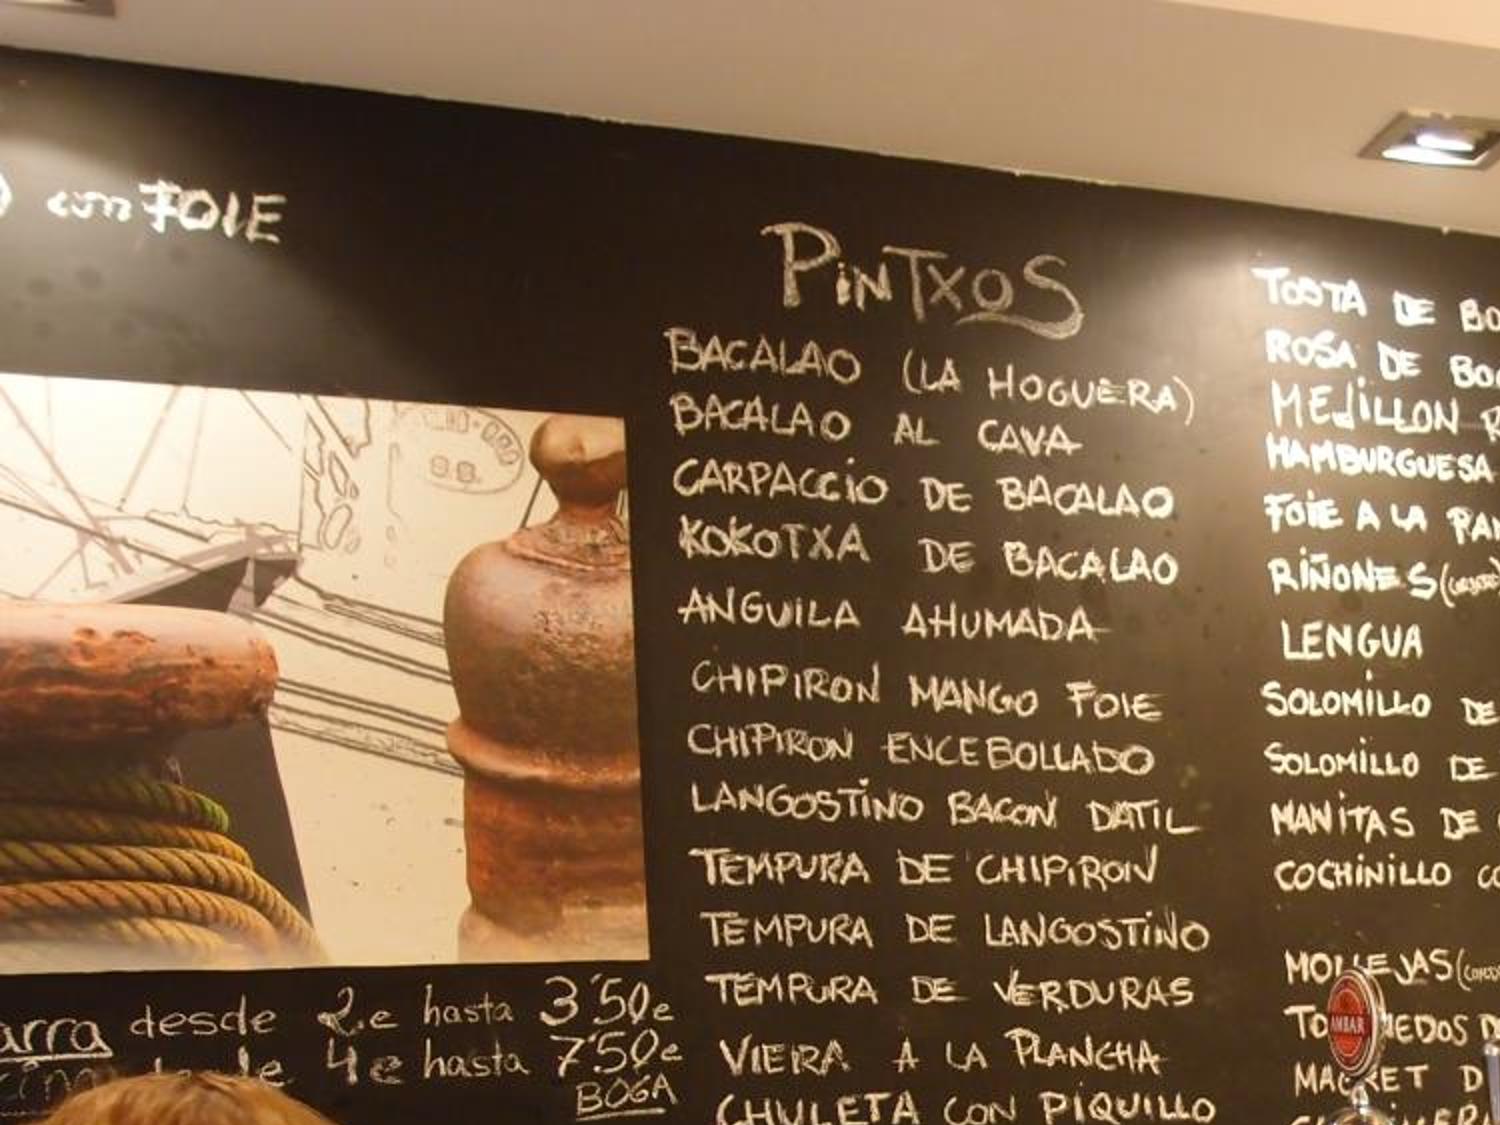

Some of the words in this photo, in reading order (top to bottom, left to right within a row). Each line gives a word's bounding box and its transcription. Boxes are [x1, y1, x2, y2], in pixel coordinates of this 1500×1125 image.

[139, 179, 287, 243] FOIE
[1251, 265, 1368, 318] TOSTA
[1393, 290, 1436, 325] DE
[664, 326, 861, 384] BACALAO
[902, 348, 963, 395] (LA
[988, 364, 1195, 425] HOGUERA)
[1265, 329, 1357, 370] ROSA
[1377, 342, 1422, 380] DE
[670, 395, 851, 440] BACALAO
[893, 413, 939, 446] AL
[978, 419, 1083, 455] CAVA
[1271, 377, 1461, 434] MEJILLON
[1265, 432, 1494, 483] HAMBURGUESA
[672, 457, 888, 505] CARPACCIO
[920, 475, 972, 513] DE
[996, 475, 1174, 518] BACALAO
[1263, 490, 1342, 533] FOIE
[1355, 499, 1380, 531] A
[1392, 500, 1428, 532] LA
[678, 516, 871, 562] KOKOTXA
[918, 538, 978, 574] DE
[1003, 541, 1178, 585] BACALAO
[678, 587, 860, 630] ANGUILA
[902, 602, 1112, 642] AHUMADA
[1281, 620, 1424, 660] LENGUA
[691, 660, 880, 705] CHIPIRON
[909, 675, 1039, 717] MANGO
[1066, 680, 1163, 722] FOIE
[1261, 670, 1431, 718] SOLOMILLO
[687, 723, 853, 761] CHIPIRON
[886, 731, 1155, 776] ENCEBOLLADO
[1263, 737, 1420, 778] SOLOMILLO
[1450, 755, 1498, 783] DE
[691, 777, 925, 824] LANGOSTINO
[948, 794, 1058, 828] BACON
[1090, 798, 1204, 835] DATIL
[1270, 792, 1415, 843] MANITAS
[1440, 806, 1481, 840] DE
[687, 847, 871, 887] TEMPURA
[897, 848, 955, 886] DE
[974, 844, 1159, 891] CHIPIRON
[1274, 852, 1452, 892] COCHINILLO
[701, 910, 874, 949] TEMPURA
[905, 914, 957, 946] DE
[983, 909, 1211, 953] LANGOSTINO
[129, 996, 277, 1038] desde
[423, 983, 515, 1026] hasta
[704, 971, 878, 1006] TEMPURA
[911, 974, 970, 1003] DE
[993, 968, 1196, 1014] VERDURAS
[423, 1037, 531, 1080] hasta
[718, 1034, 850, 1077] VIERA
[892, 1037, 919, 1072] A
[945, 1040, 988, 1072] LA
[1004, 1027, 1167, 1074] PLANCHA
